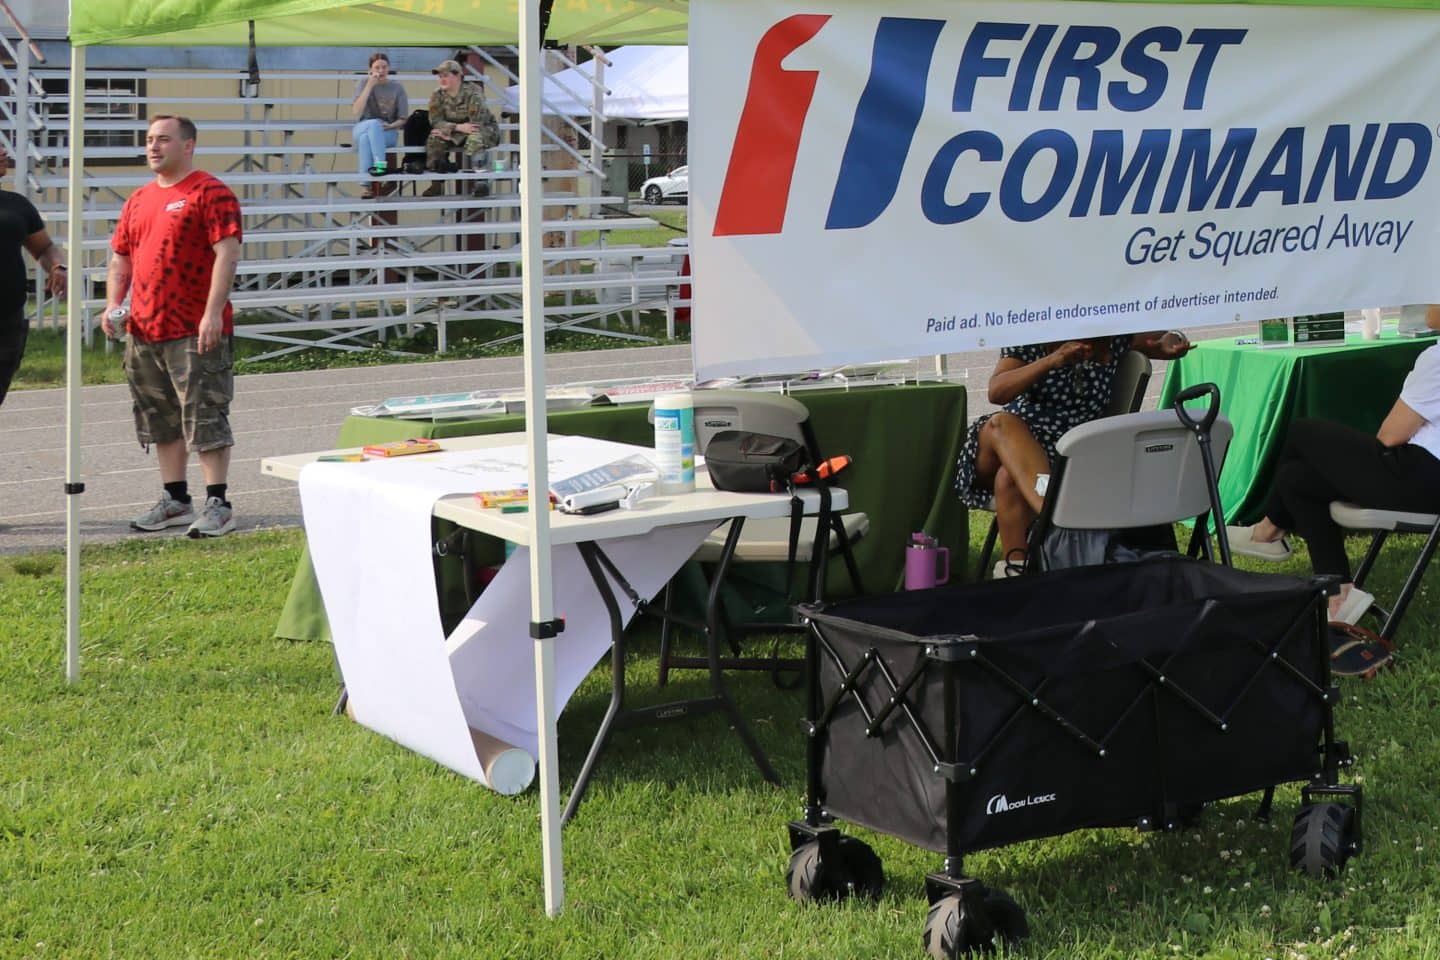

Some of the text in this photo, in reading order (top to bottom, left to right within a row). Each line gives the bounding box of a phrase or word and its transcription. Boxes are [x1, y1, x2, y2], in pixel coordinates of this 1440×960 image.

[951, 21, 1249, 113] FIRST
[920, 120, 1433, 226] COMMAND
[1124, 213, 1414, 267] Get Squared Away
[926, 286, 1279, 333] Paid ad. No federal endorsement of advertiser intended.
